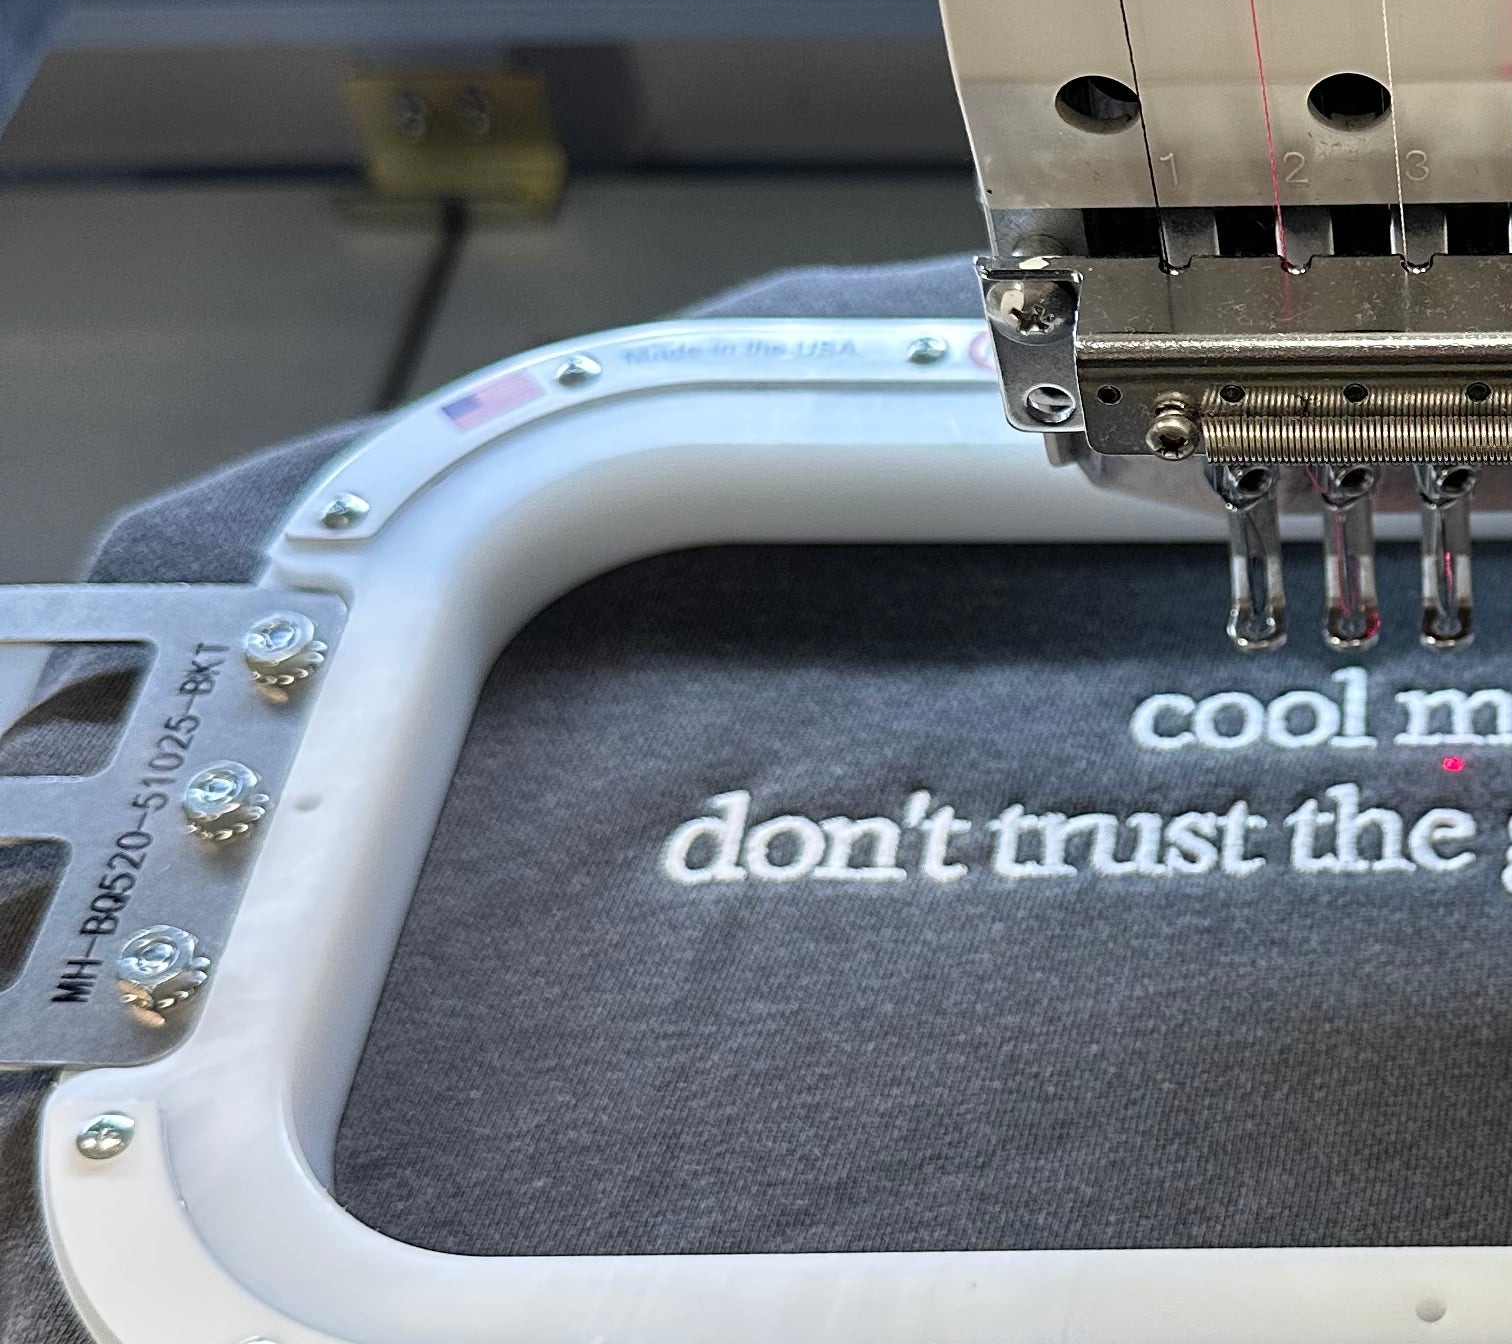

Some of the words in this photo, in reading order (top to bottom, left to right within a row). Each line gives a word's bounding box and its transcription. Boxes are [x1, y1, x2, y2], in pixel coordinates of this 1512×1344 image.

[1159, 151, 1180, 186] 1
[1283, 151, 1310, 184] 2
[1405, 149, 1430, 182] 3
[1129, 666, 1378, 750] cool
[51, 641, 231, 1005] MH-BQ520-51025-BKT
[660, 787, 971, 884] don't
[989, 798, 1268, 878] trust
[1283, 781, 1480, 875] the
